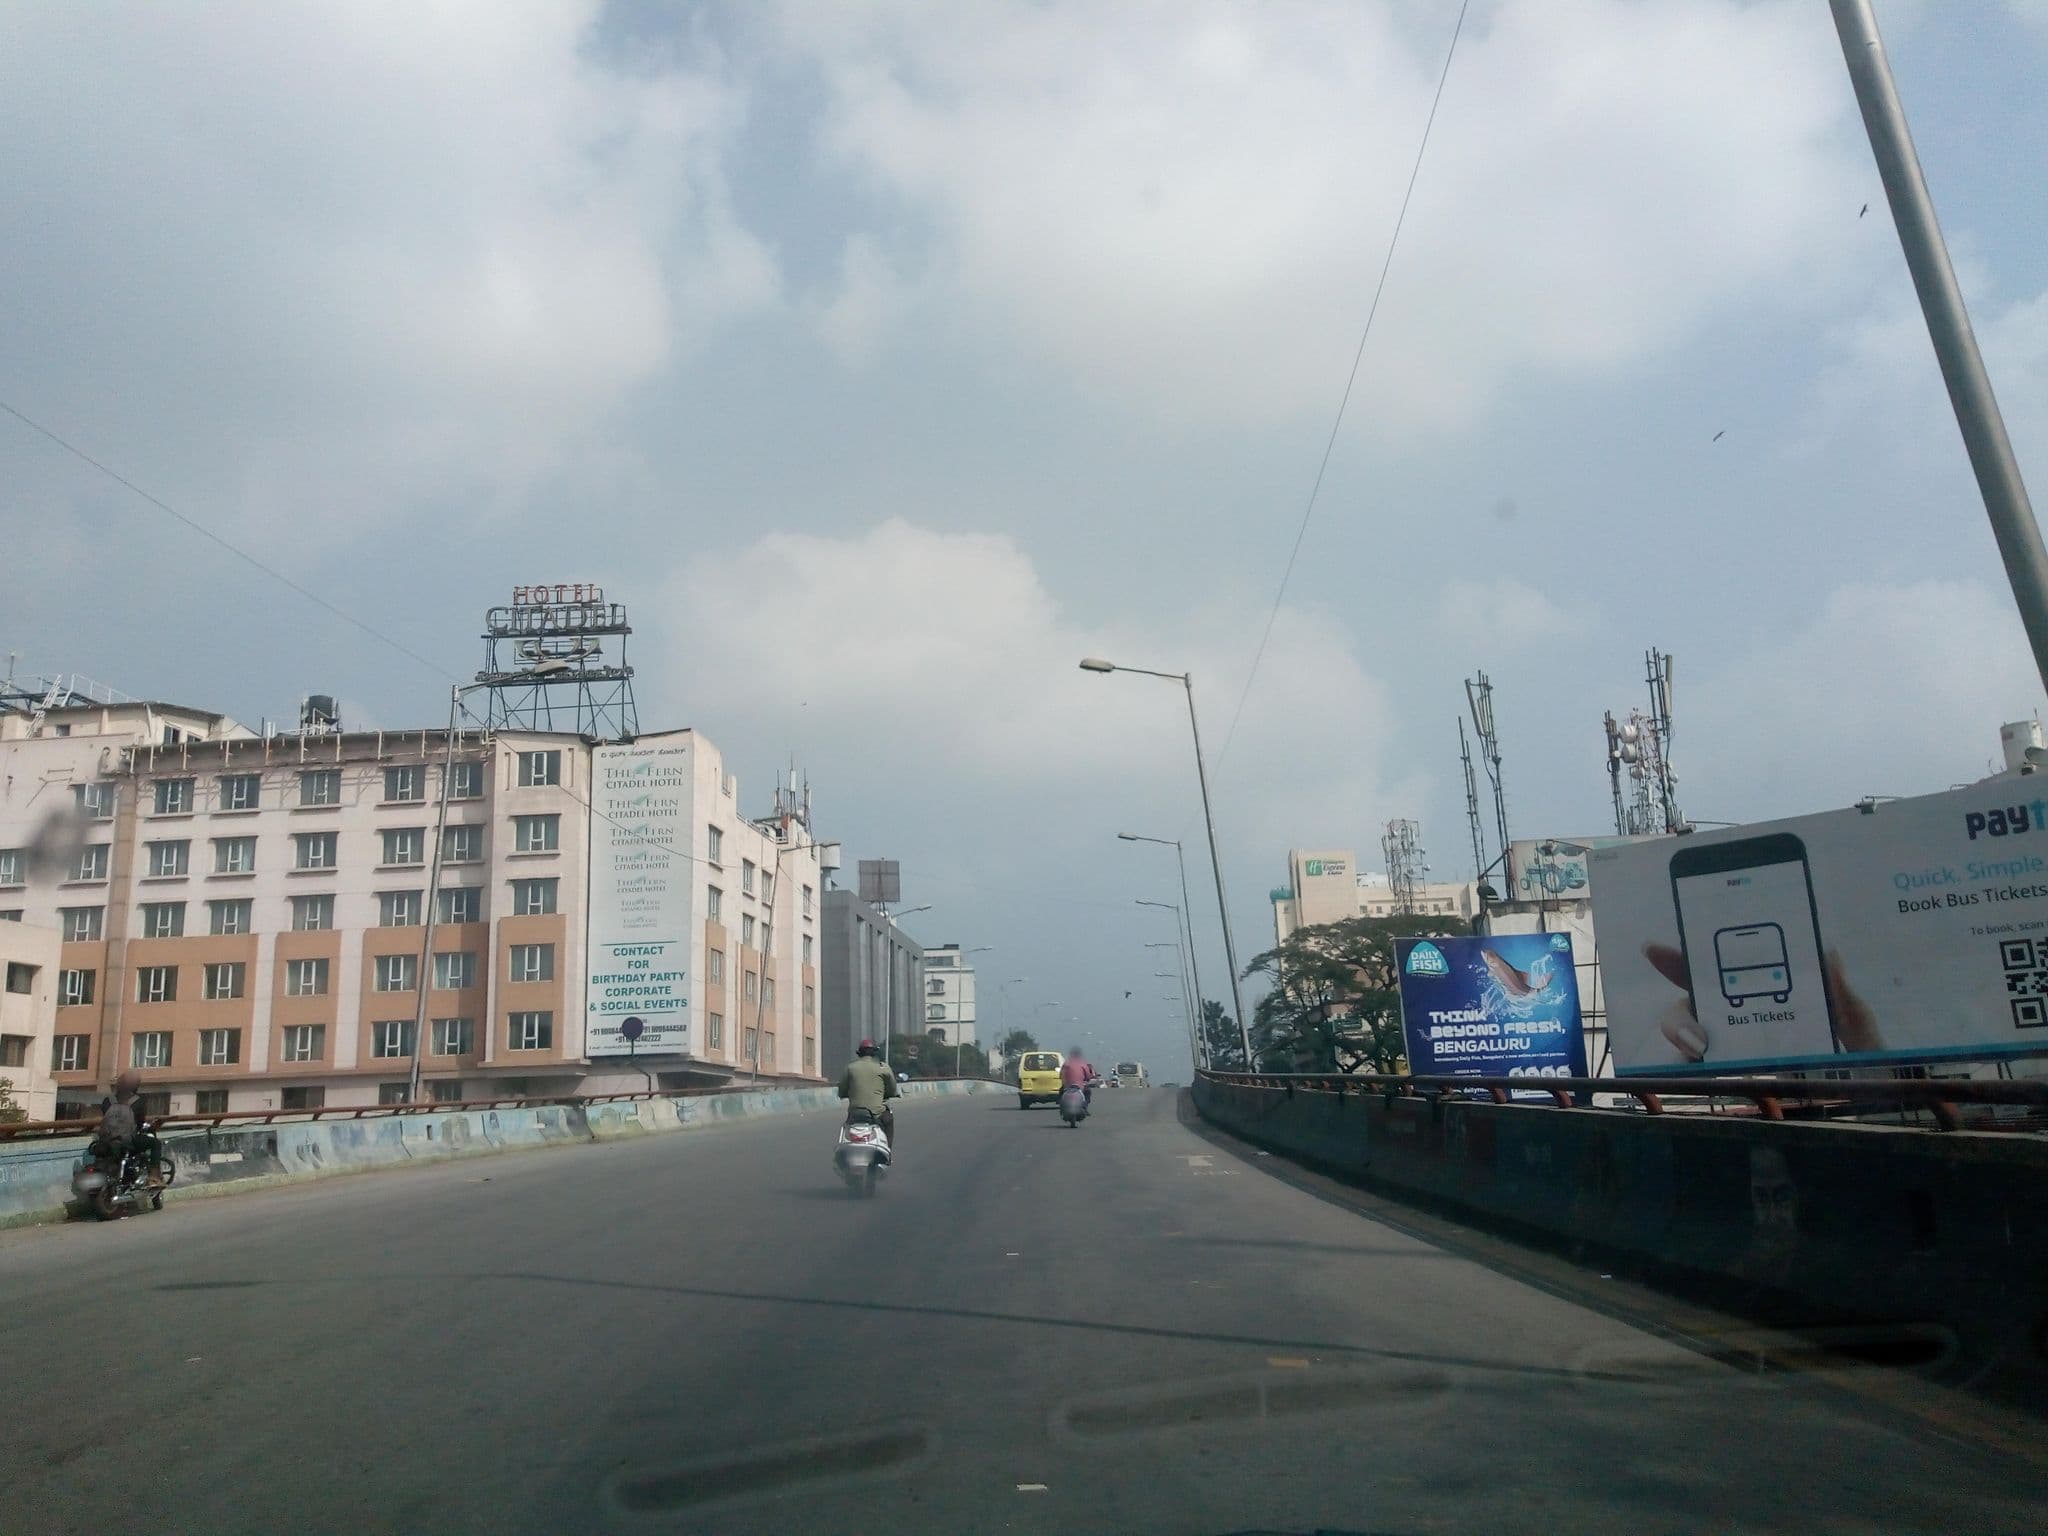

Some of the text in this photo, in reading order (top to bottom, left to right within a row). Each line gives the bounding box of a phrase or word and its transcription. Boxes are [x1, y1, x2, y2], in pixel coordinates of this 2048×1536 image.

[513, 584, 601, 605] HOTEL
[486, 603, 626, 634] CITADEL
[647, 767, 683, 777] FERN
[606, 778, 683, 789] CITADEL HOTEL
[608, 808, 677, 819] CITADEL HOTEL
[1898, 884, 2048, 914] Book Bus Tickets
[1970, 927, 1984, 936] To
[2018, 921, 2045, 932] scan
[613, 946, 664, 957] CONTACT
[1411, 951, 1439, 960] DAILY
[628, 960, 650, 969] FOR
[1412, 959, 1442, 970] FISH
[592, 972, 686, 984] BIRTHDAY PARTY
[605, 986, 672, 997] CORPORATE
[589, 999, 688, 1012] & SOCIAL EVENTS
[1429, 1009, 1488, 1024] THINK
[1727, 1009, 1796, 1026] Bus Tickets
[1430, 1020, 1566, 1039] BEYOND FRESH,
[1433, 1037, 1531, 1054] BENGALURU
